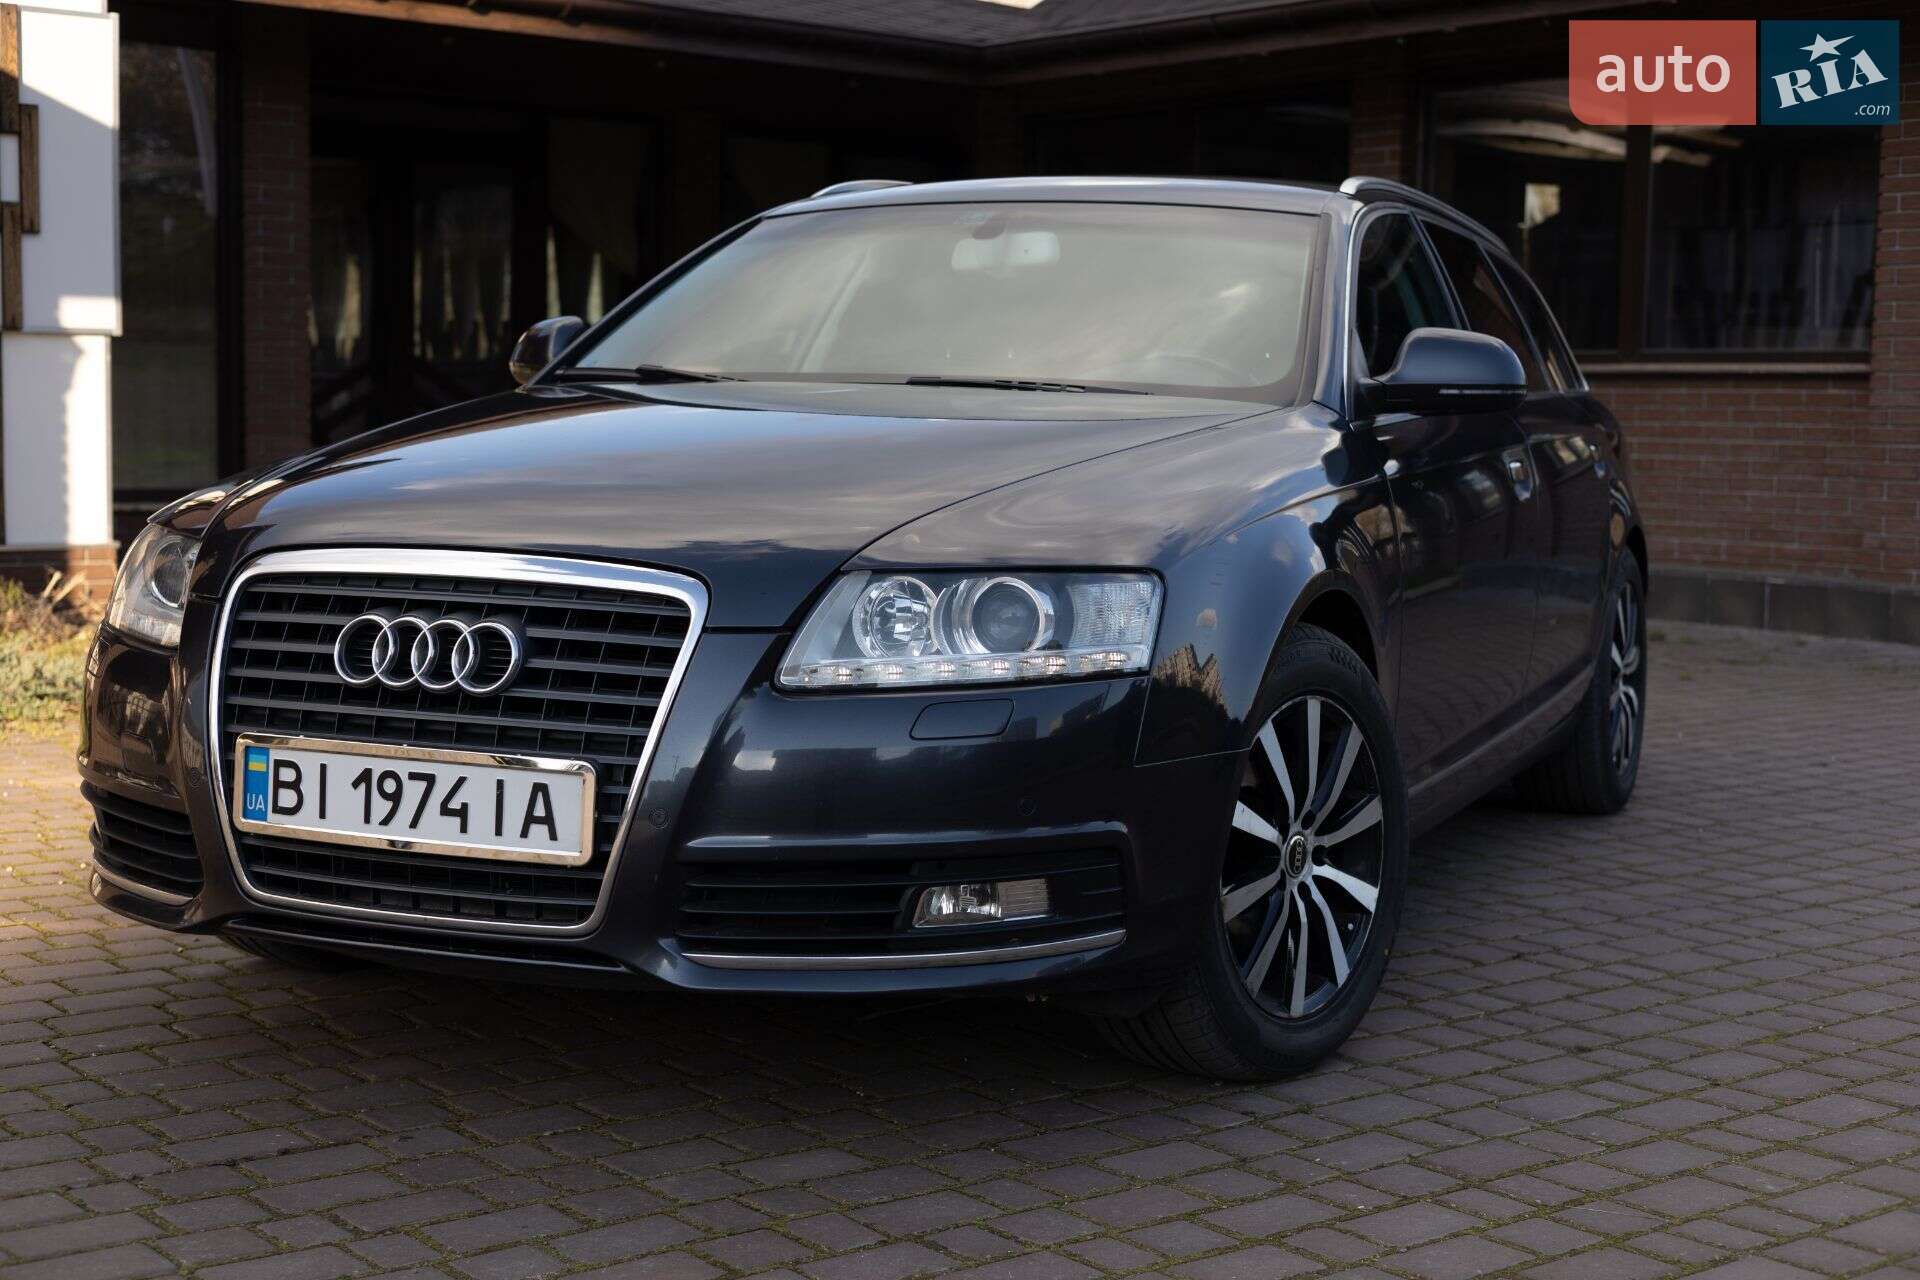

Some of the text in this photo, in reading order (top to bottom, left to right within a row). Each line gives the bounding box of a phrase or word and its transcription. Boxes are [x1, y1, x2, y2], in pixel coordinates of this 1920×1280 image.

[246, 793, 266, 812] UA
[271, 758, 559, 841] BI 1974 IA
